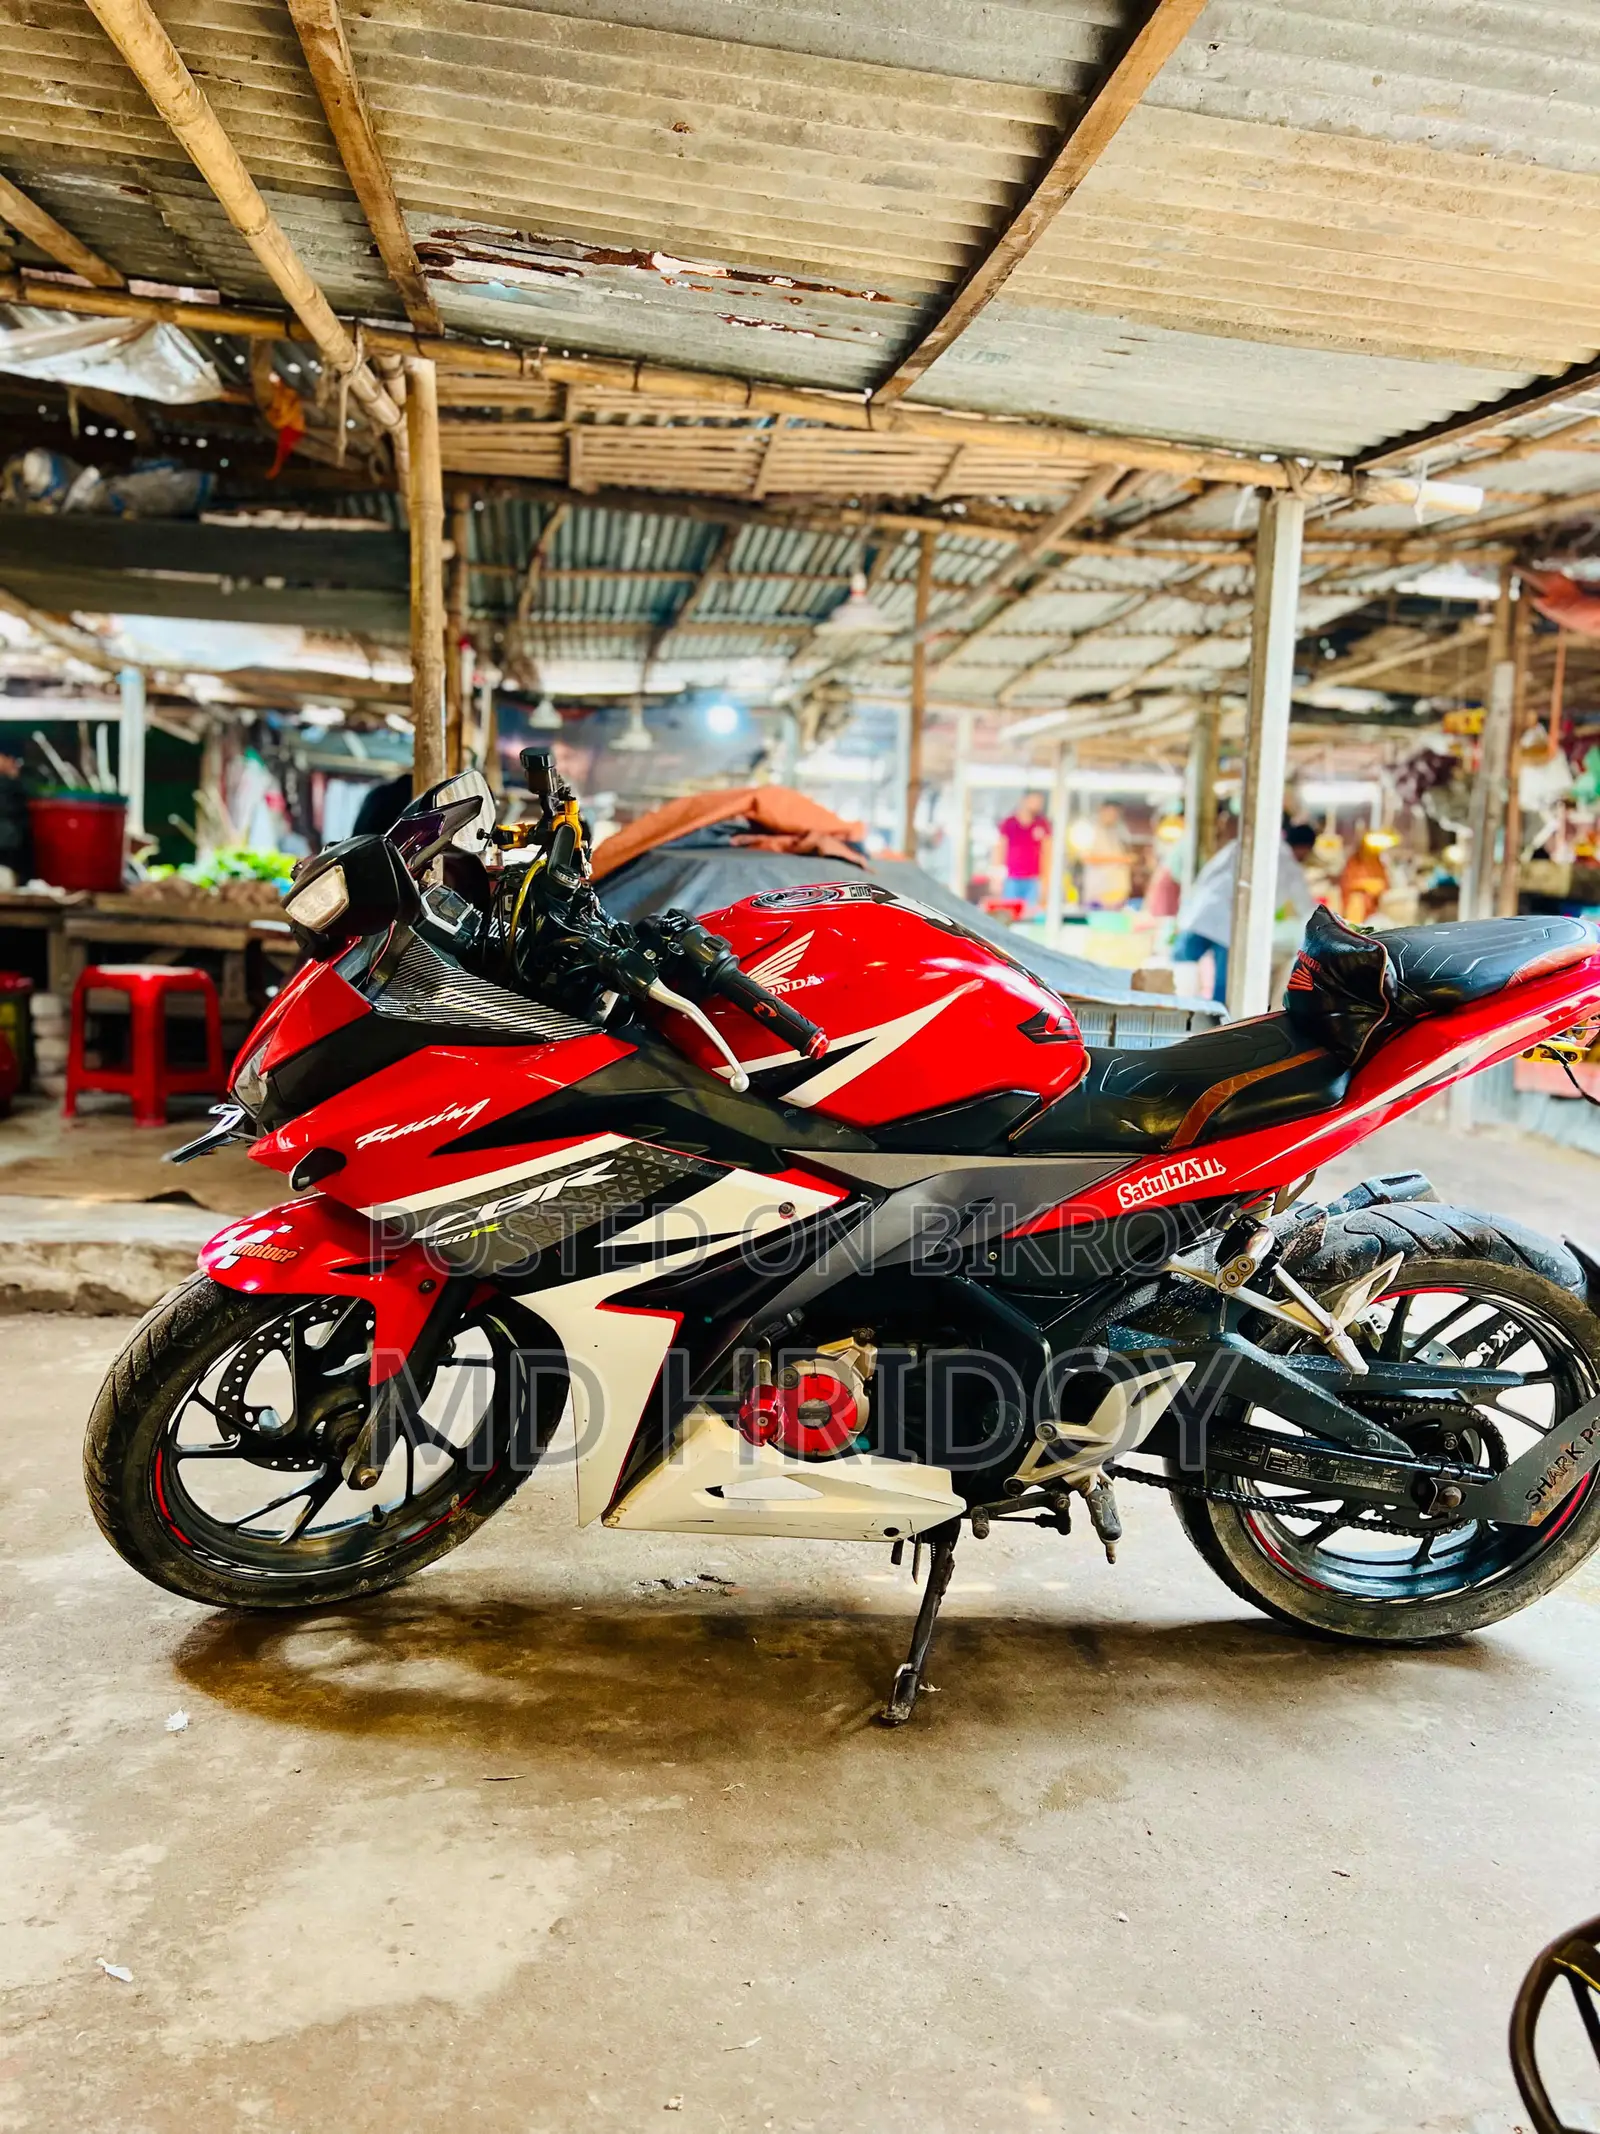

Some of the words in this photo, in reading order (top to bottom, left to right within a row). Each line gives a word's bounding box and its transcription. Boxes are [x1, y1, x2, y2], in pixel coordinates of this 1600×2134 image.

[766, 973, 824, 996] ONDA
[355, 1098, 491, 1149] Racing
[411, 1158, 619, 1239] CBR
[1525, 1441, 1586, 1506] SHARK
